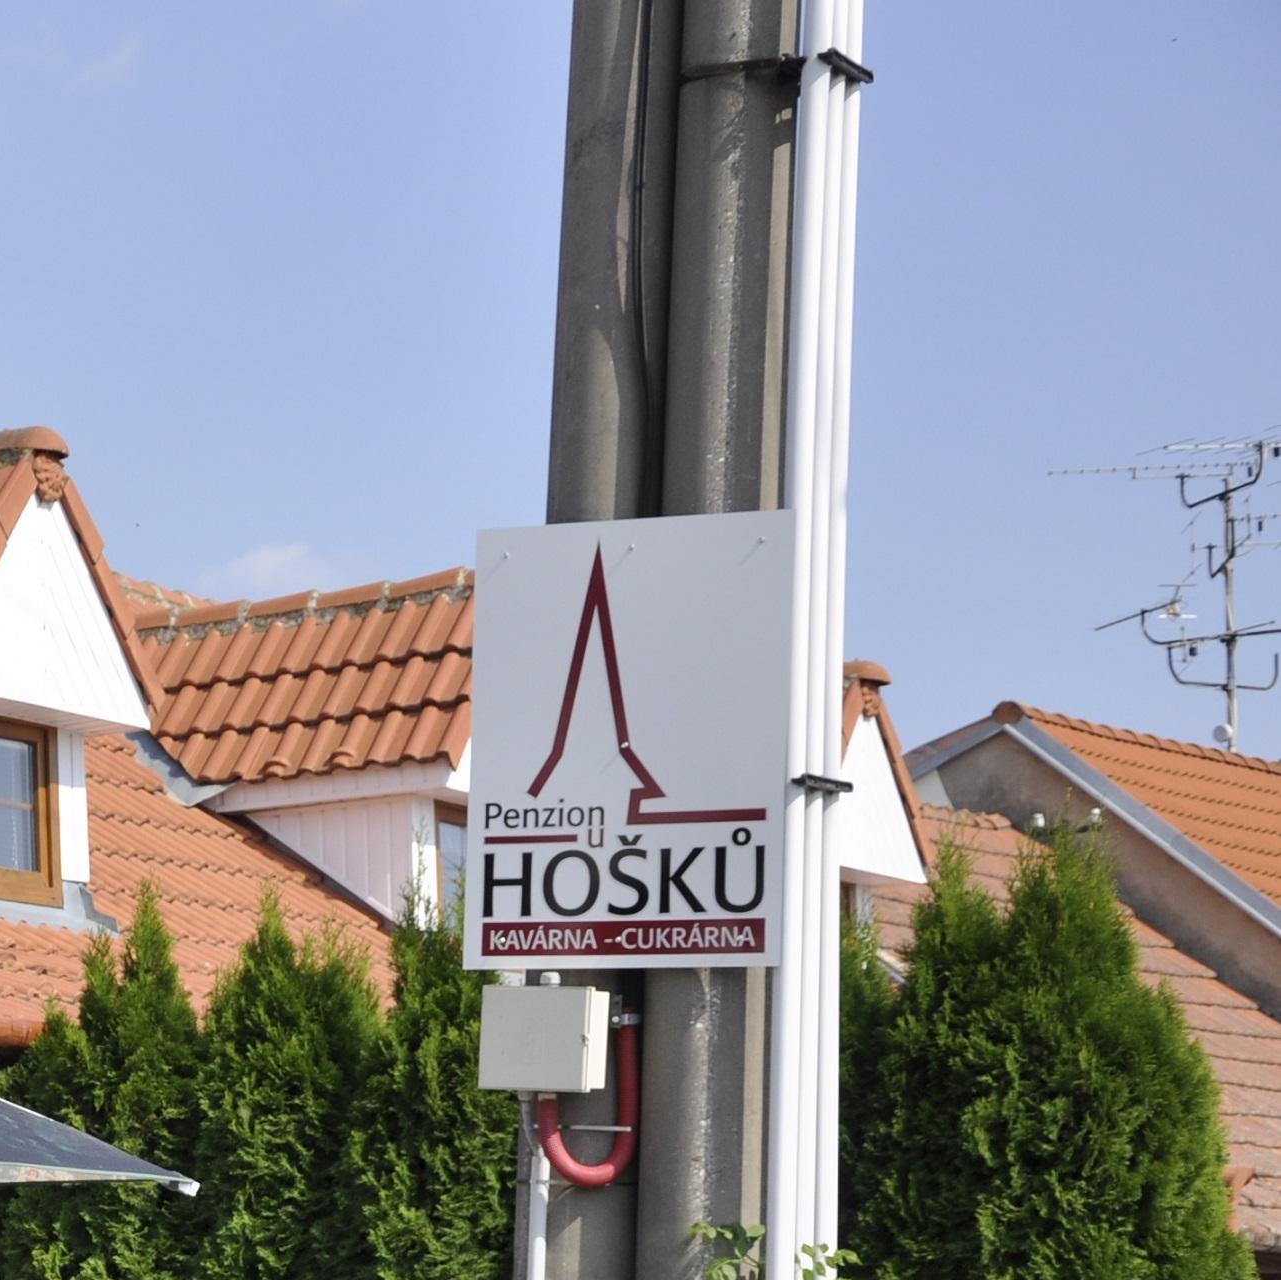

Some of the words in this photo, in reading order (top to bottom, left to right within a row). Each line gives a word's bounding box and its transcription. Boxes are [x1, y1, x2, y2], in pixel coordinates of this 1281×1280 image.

[485, 799, 605, 829] Penzion
[483, 827, 766, 917] HOŠKŮ
[490, 926, 597, 950] KAVÁRNA
[621, 923, 756, 949] CUKRÁRNA
